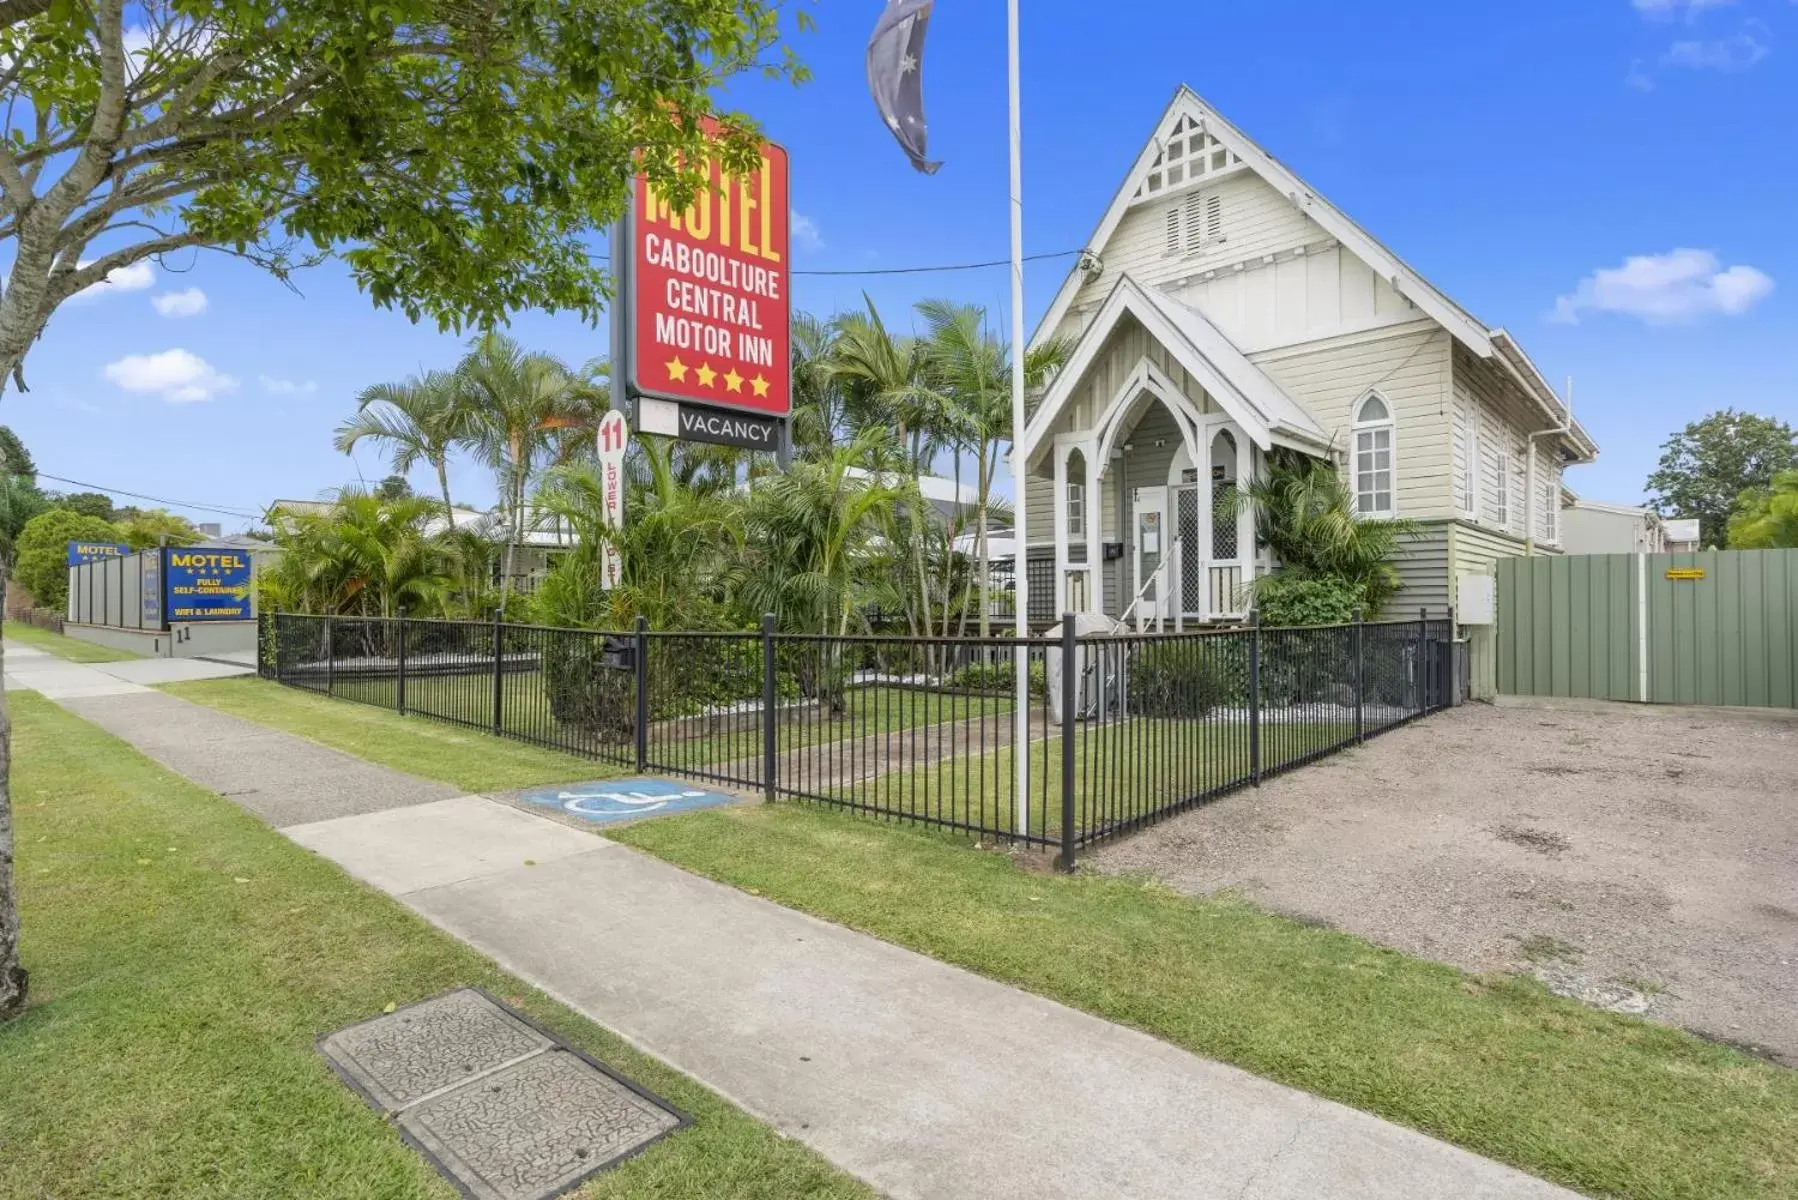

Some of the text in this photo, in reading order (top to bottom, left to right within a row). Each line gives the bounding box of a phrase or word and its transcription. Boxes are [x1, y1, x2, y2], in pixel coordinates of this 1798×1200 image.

[646, 233, 780, 300] CABOOLTURE
[667, 278, 763, 330] CENTRAL
[656, 312, 773, 367] MOTOR INN
[602, 418, 622, 453] 11
[681, 412, 772, 442] VACANCY
[608, 462, 617, 510] LOWER
[77, 544, 122, 556] MOTEL
[172, 554, 245, 568] MOTEL
[197, 578, 221, 586] FULLY
[204, 608, 242, 616] LAUNDRY
